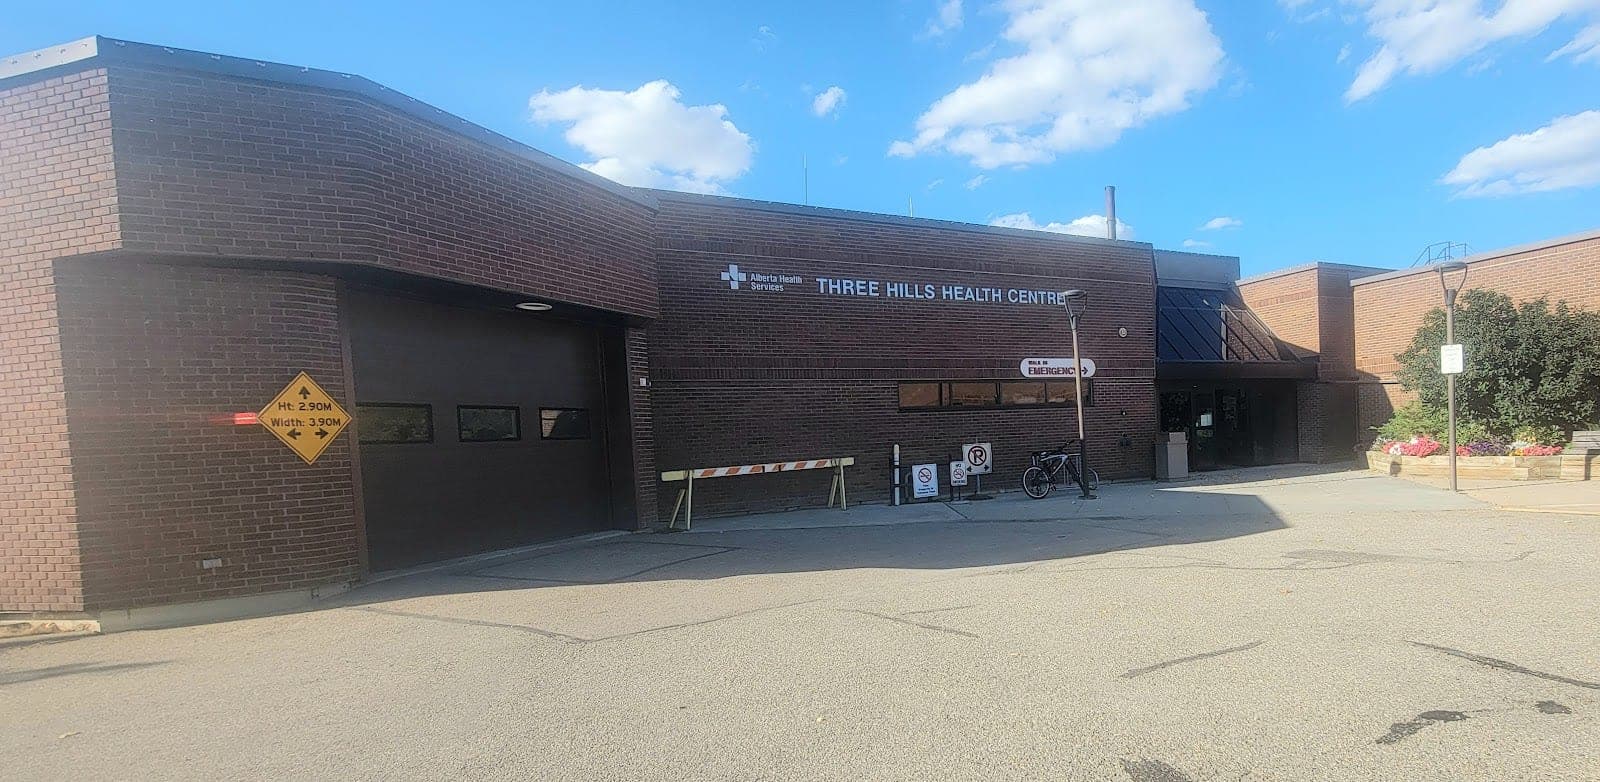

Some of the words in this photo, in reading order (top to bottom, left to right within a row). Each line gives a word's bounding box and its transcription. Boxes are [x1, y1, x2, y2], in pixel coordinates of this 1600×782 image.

[750, 273, 777, 283] Alberta
[779, 275, 803, 284] Health
[750, 282, 785, 292] Services
[815, 277, 880, 297] THREE
[886, 281, 936, 300] HILLS
[942, 285, 1002, 303] HEALTH
[1007, 288, 1065, 305] CENTRE
[278, 402, 294, 411] Ht:
[298, 402, 332, 411] 2.90M
[271, 417, 305, 427] Width:
[309, 417, 341, 427] 3.90M
